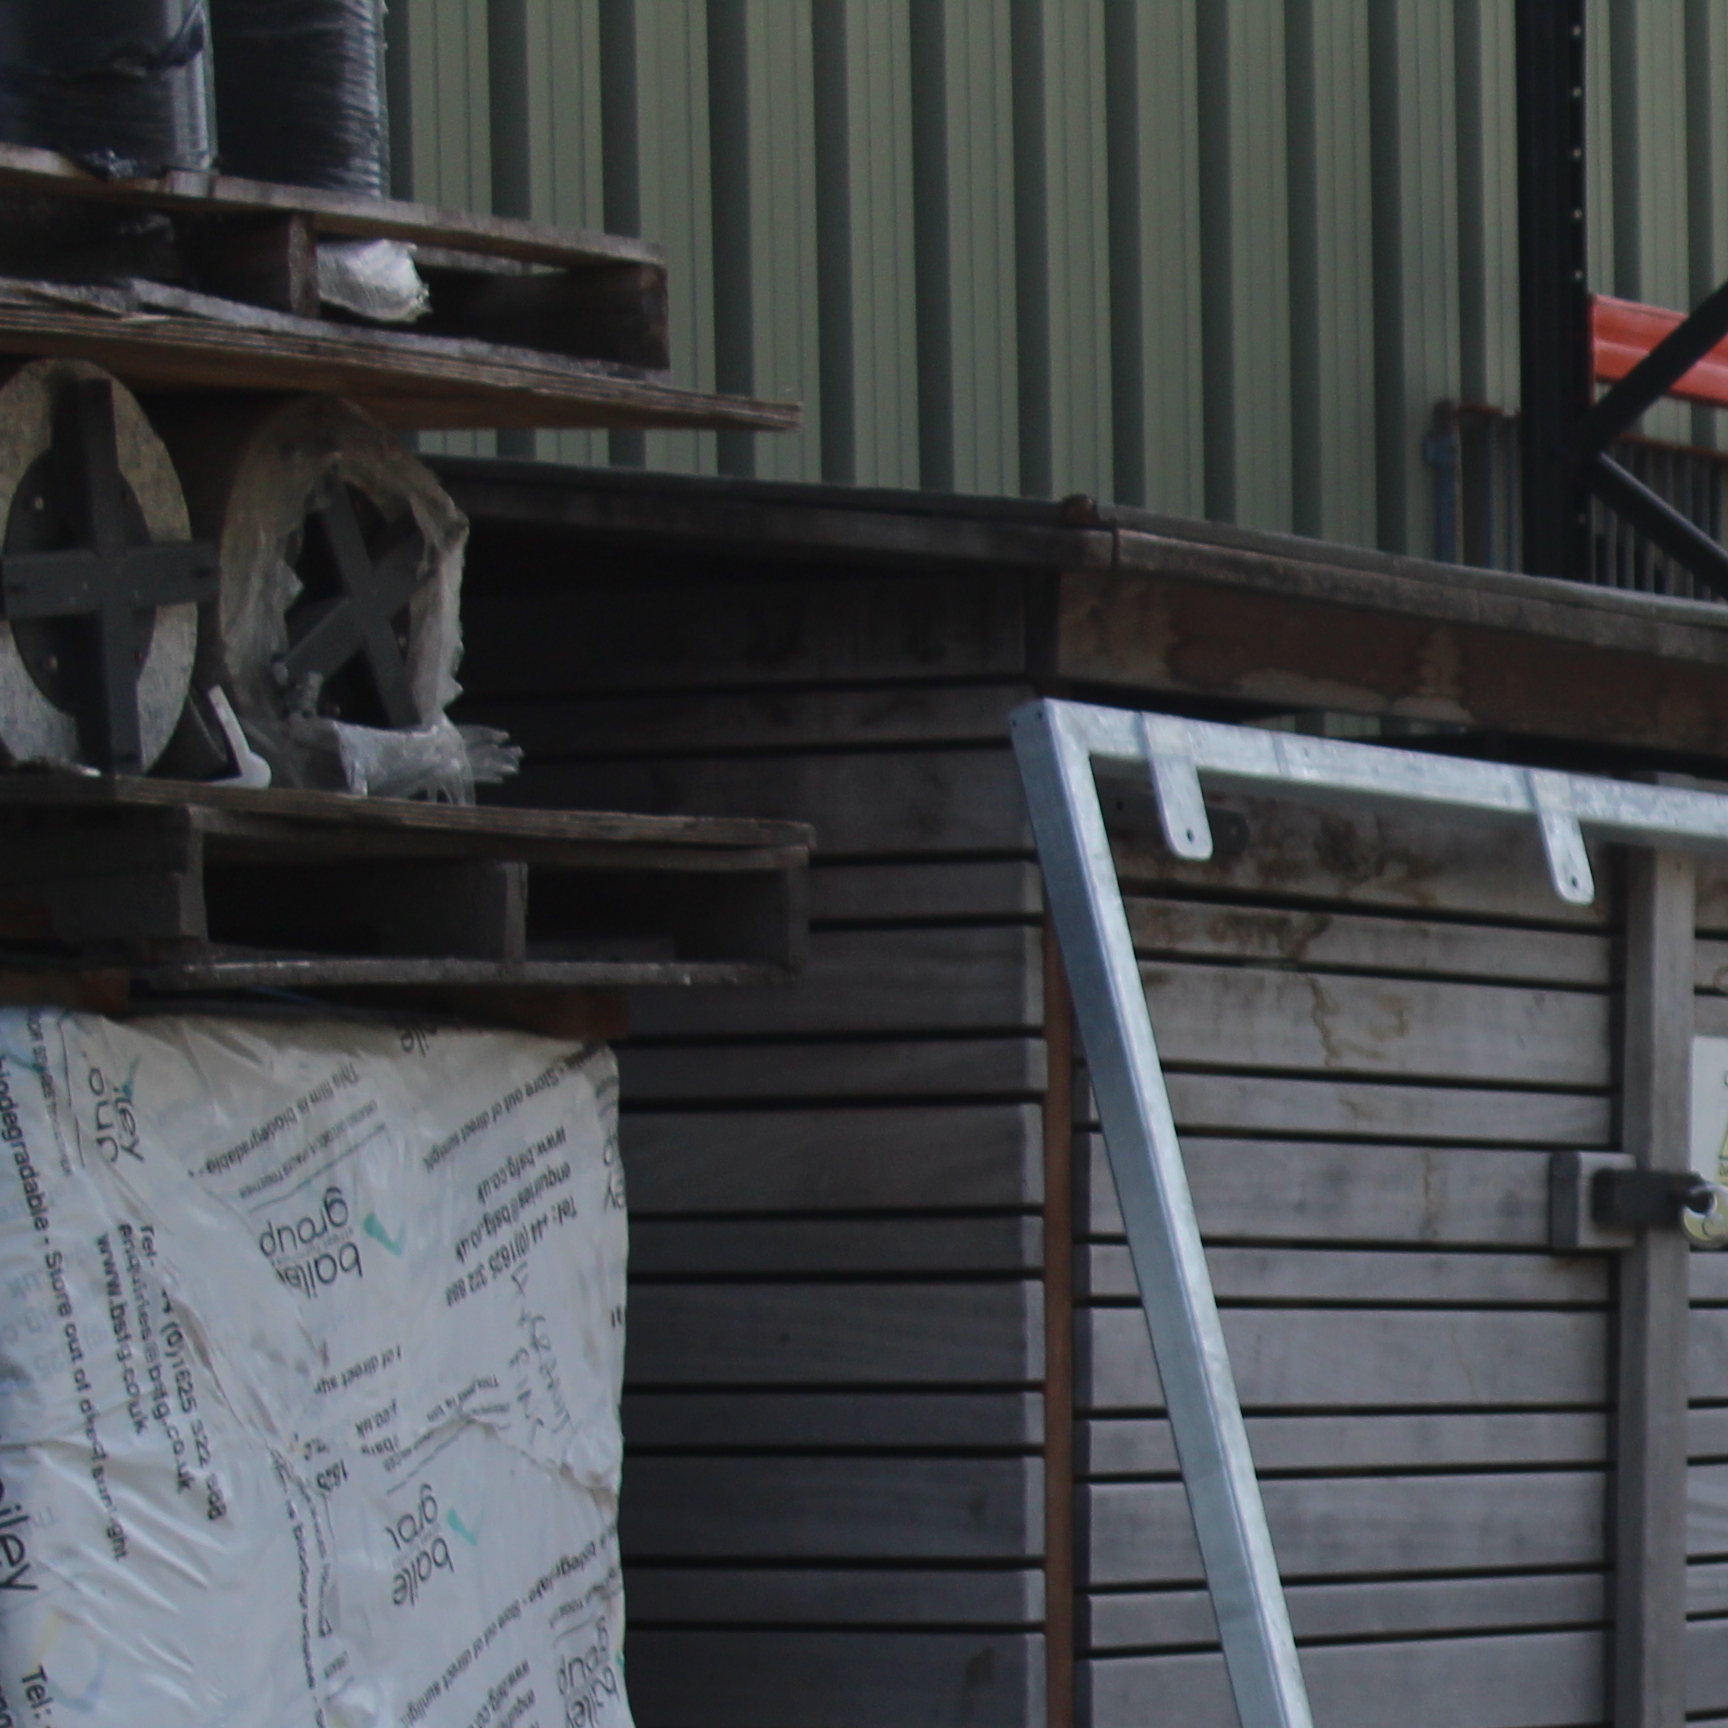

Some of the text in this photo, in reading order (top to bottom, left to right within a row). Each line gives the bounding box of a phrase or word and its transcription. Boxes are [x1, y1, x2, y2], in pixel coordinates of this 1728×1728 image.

[259, 1185, 350, 1258] group
[45, 1250, 73, 1318] Store
[63, 1322, 85, 1363] out
[22, 1664, 54, 1719] Tel:
